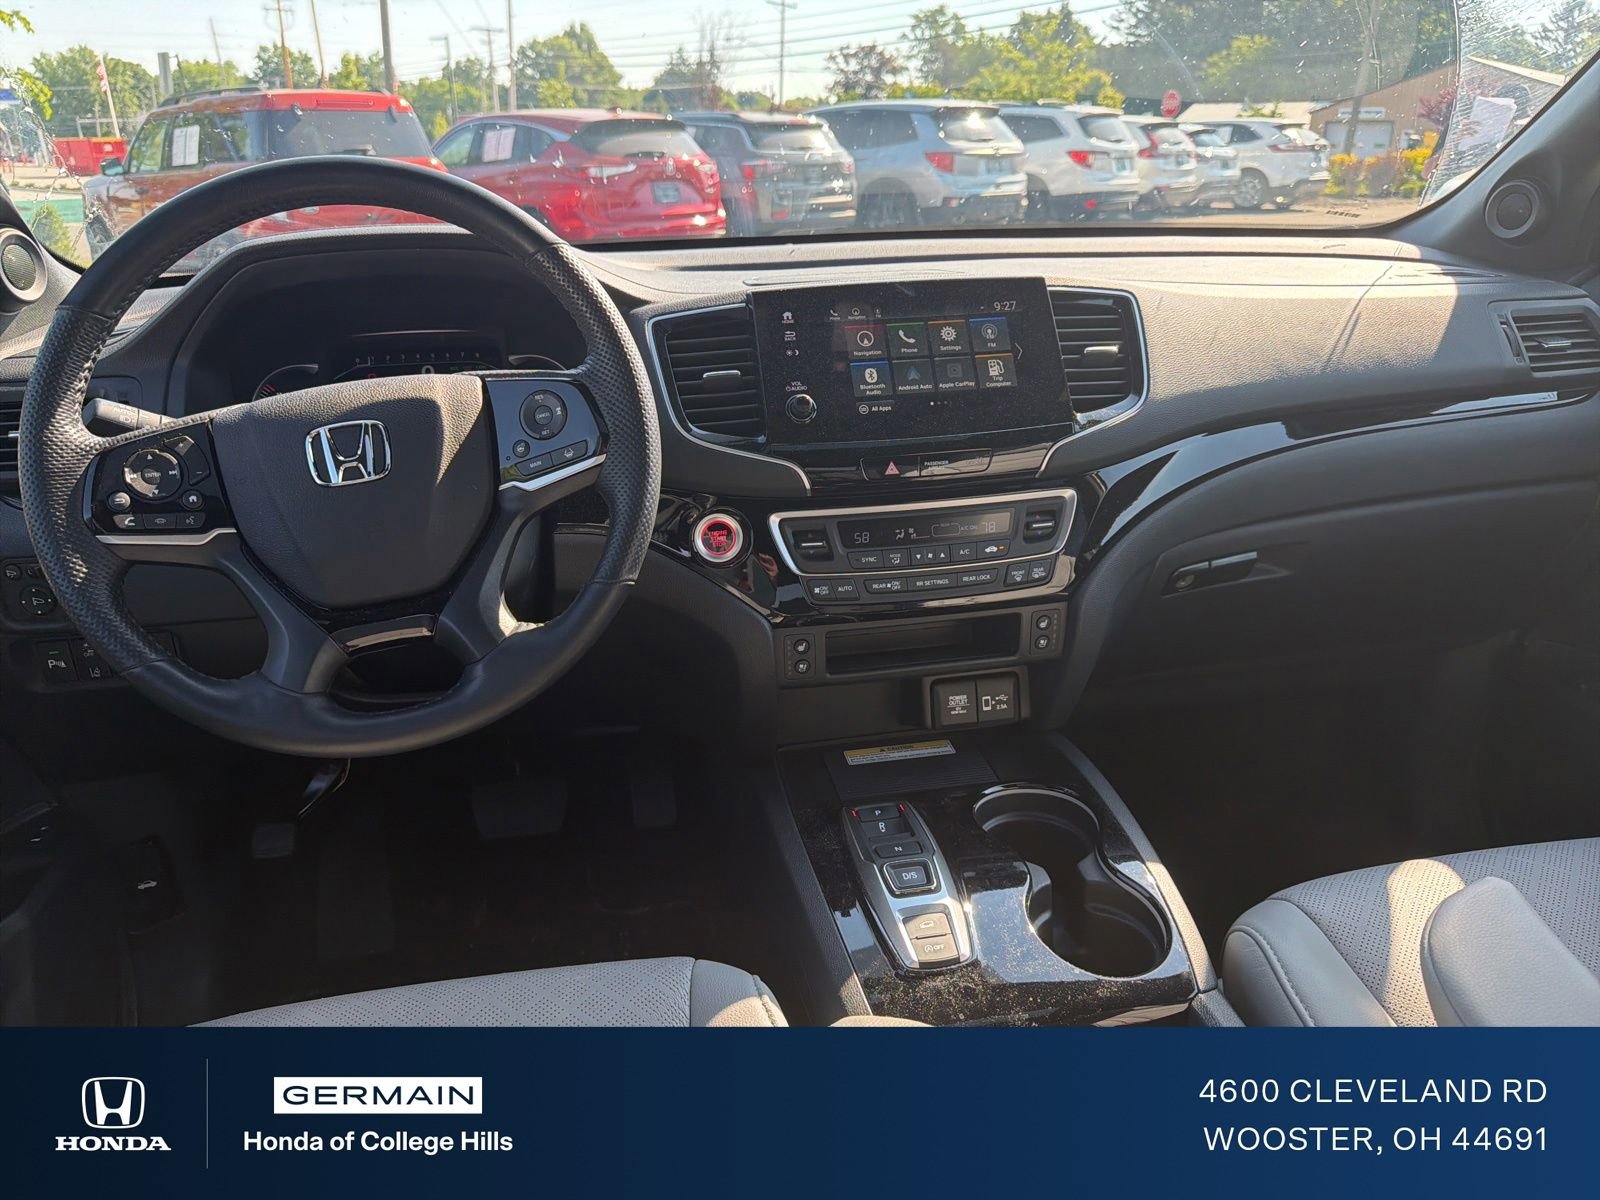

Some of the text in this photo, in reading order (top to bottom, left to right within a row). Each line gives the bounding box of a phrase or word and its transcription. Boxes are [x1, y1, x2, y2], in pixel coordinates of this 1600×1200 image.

[994, 301, 1016, 311] 9:27
[878, 822, 885, 830] R
[902, 872, 918, 880] D/S
